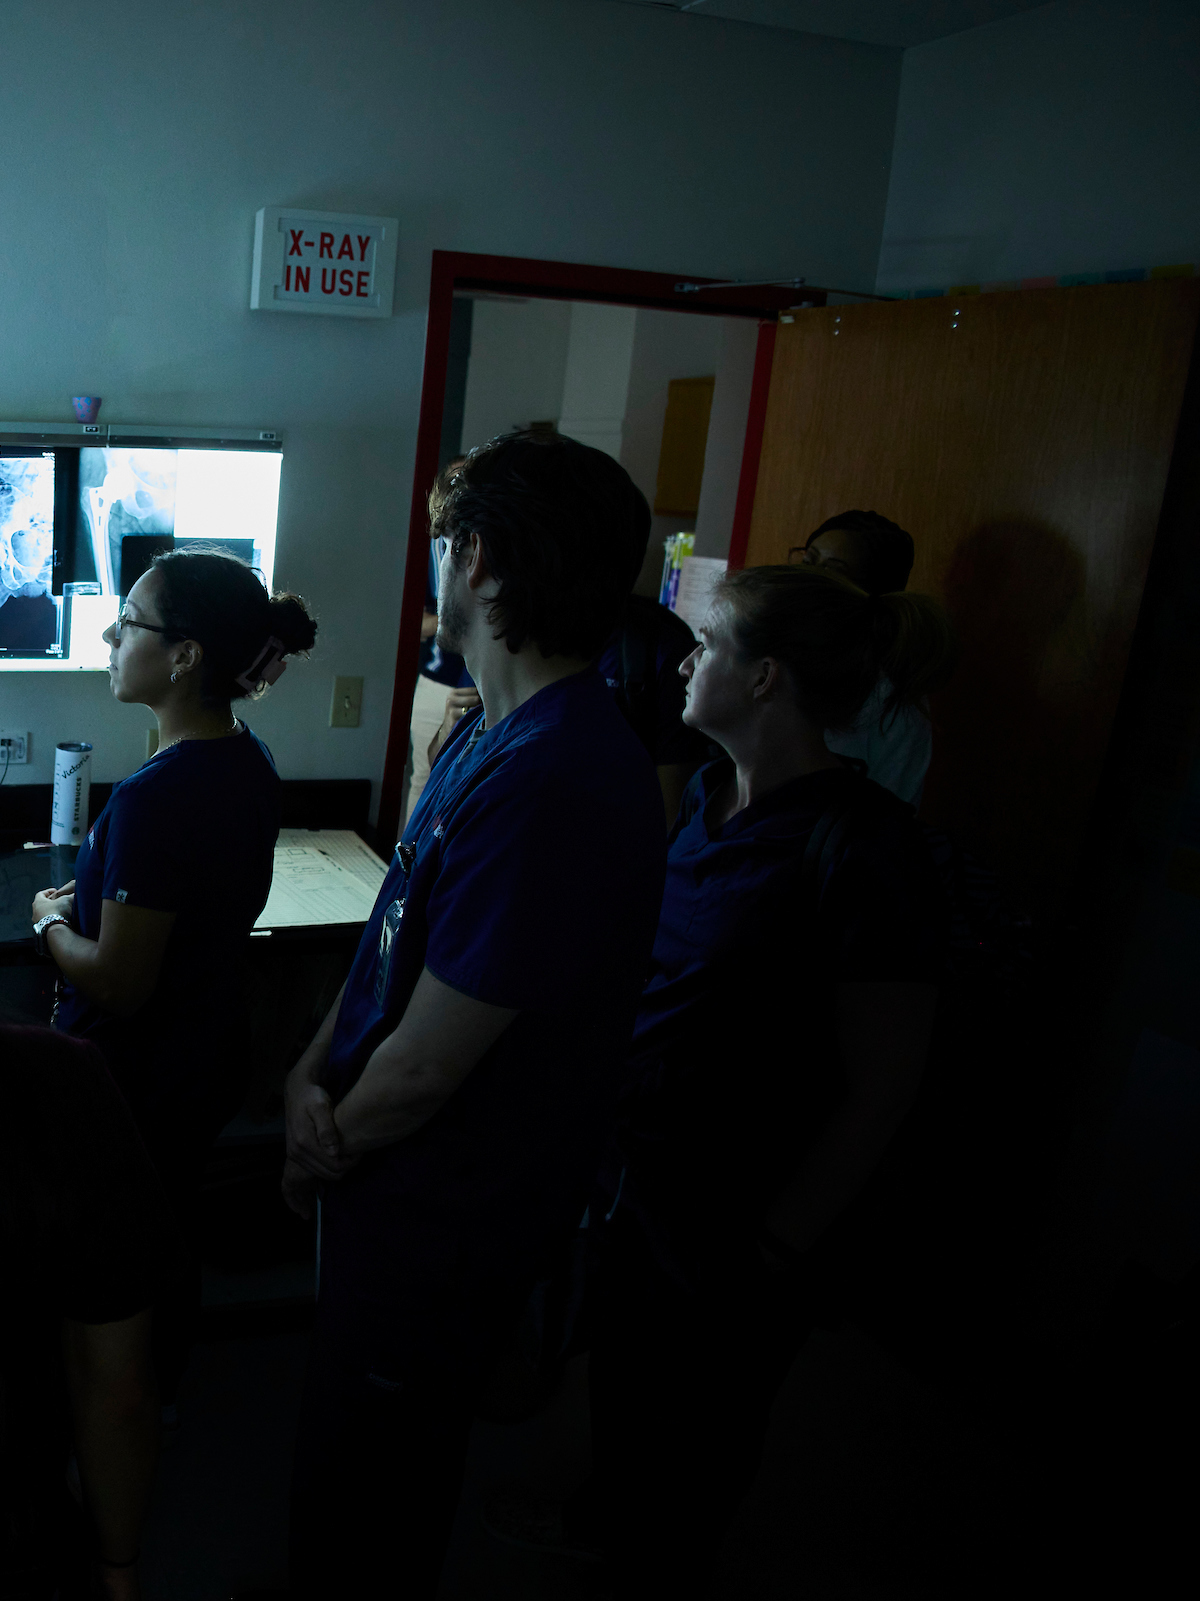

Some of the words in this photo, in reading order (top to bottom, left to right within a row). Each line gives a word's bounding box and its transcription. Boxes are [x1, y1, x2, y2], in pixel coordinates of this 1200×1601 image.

[289, 229, 370, 262] X-RAY
[285, 265, 311, 293] IN
[321, 268, 370, 297] USE
[61, 754, 90, 779] Victoria
[73, 777, 82, 821] STARBUCKS
